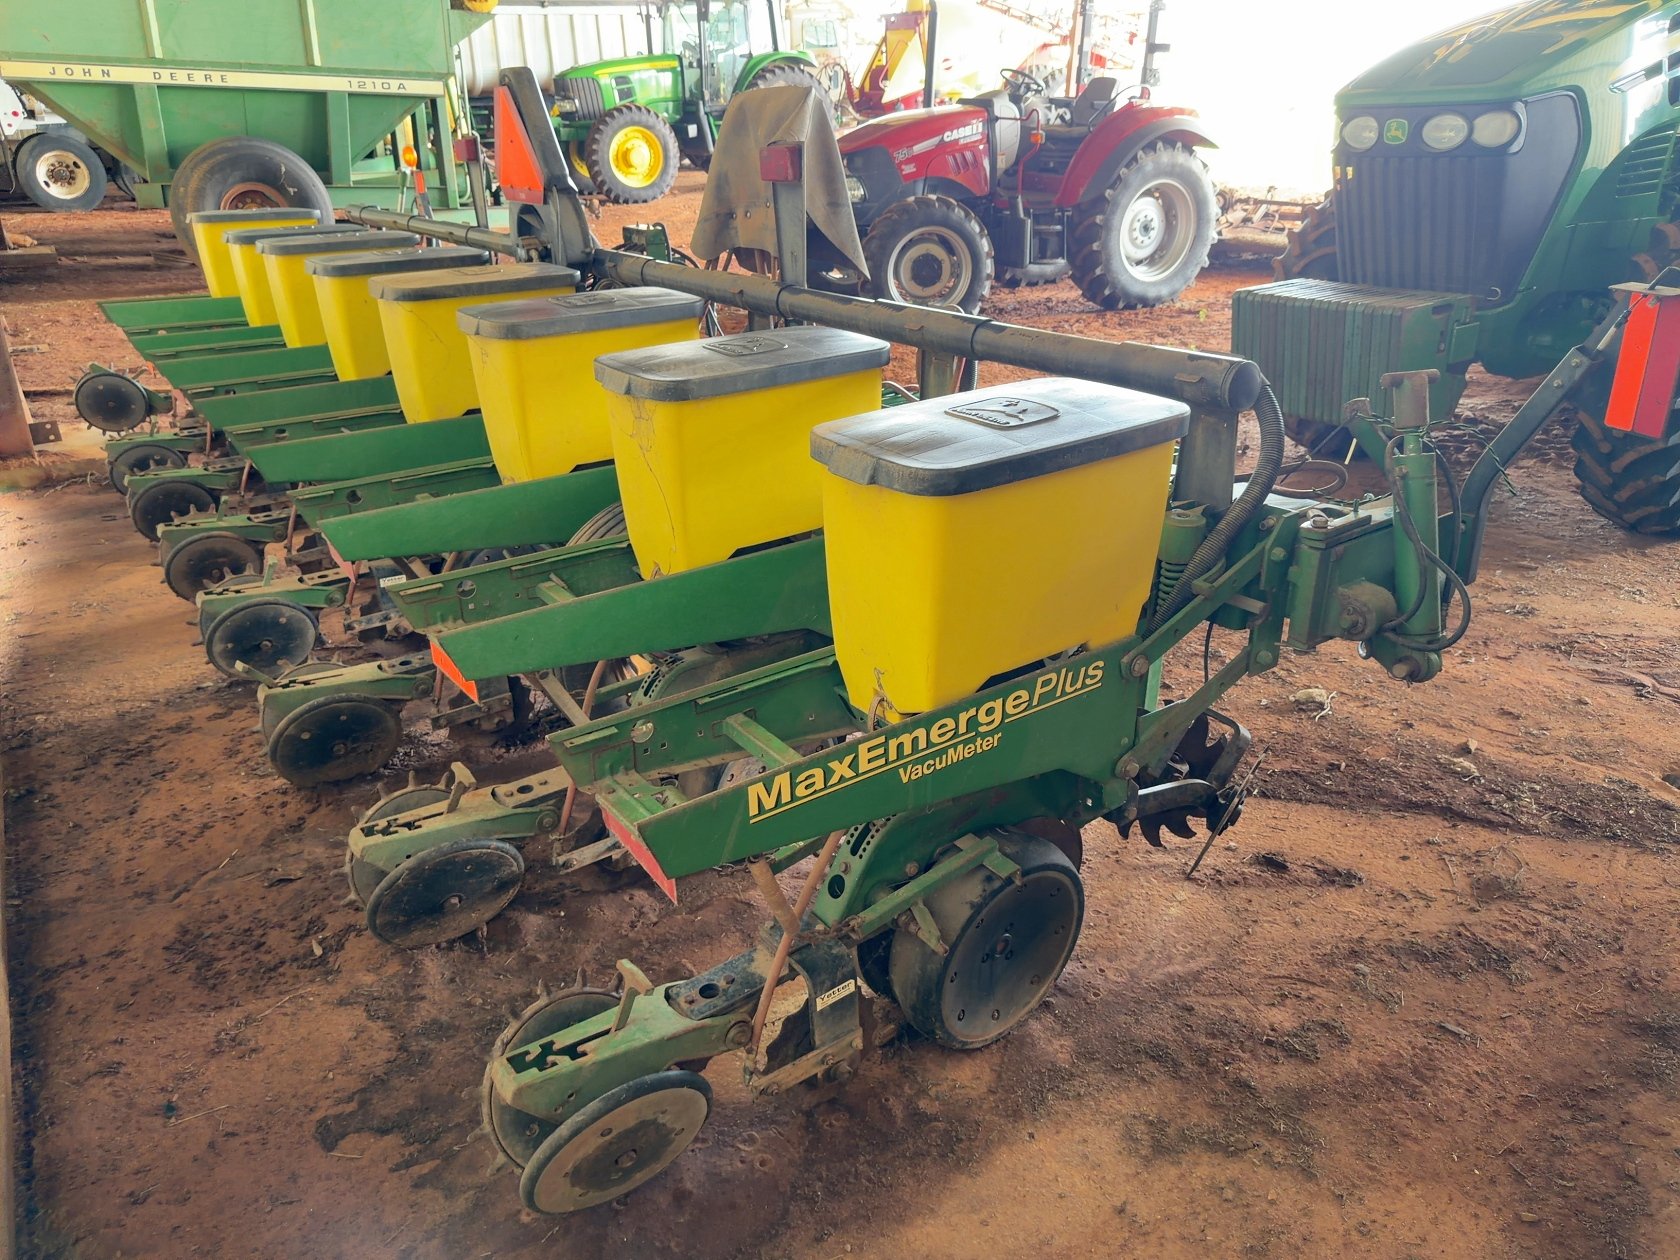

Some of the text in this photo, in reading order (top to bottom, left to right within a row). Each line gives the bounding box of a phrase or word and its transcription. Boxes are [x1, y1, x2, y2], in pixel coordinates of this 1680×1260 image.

[48, 66, 229, 83] JOHN DEERE
[898, 730, 1002, 784] VacuMeter
[820, 982, 852, 1001] Yetter
